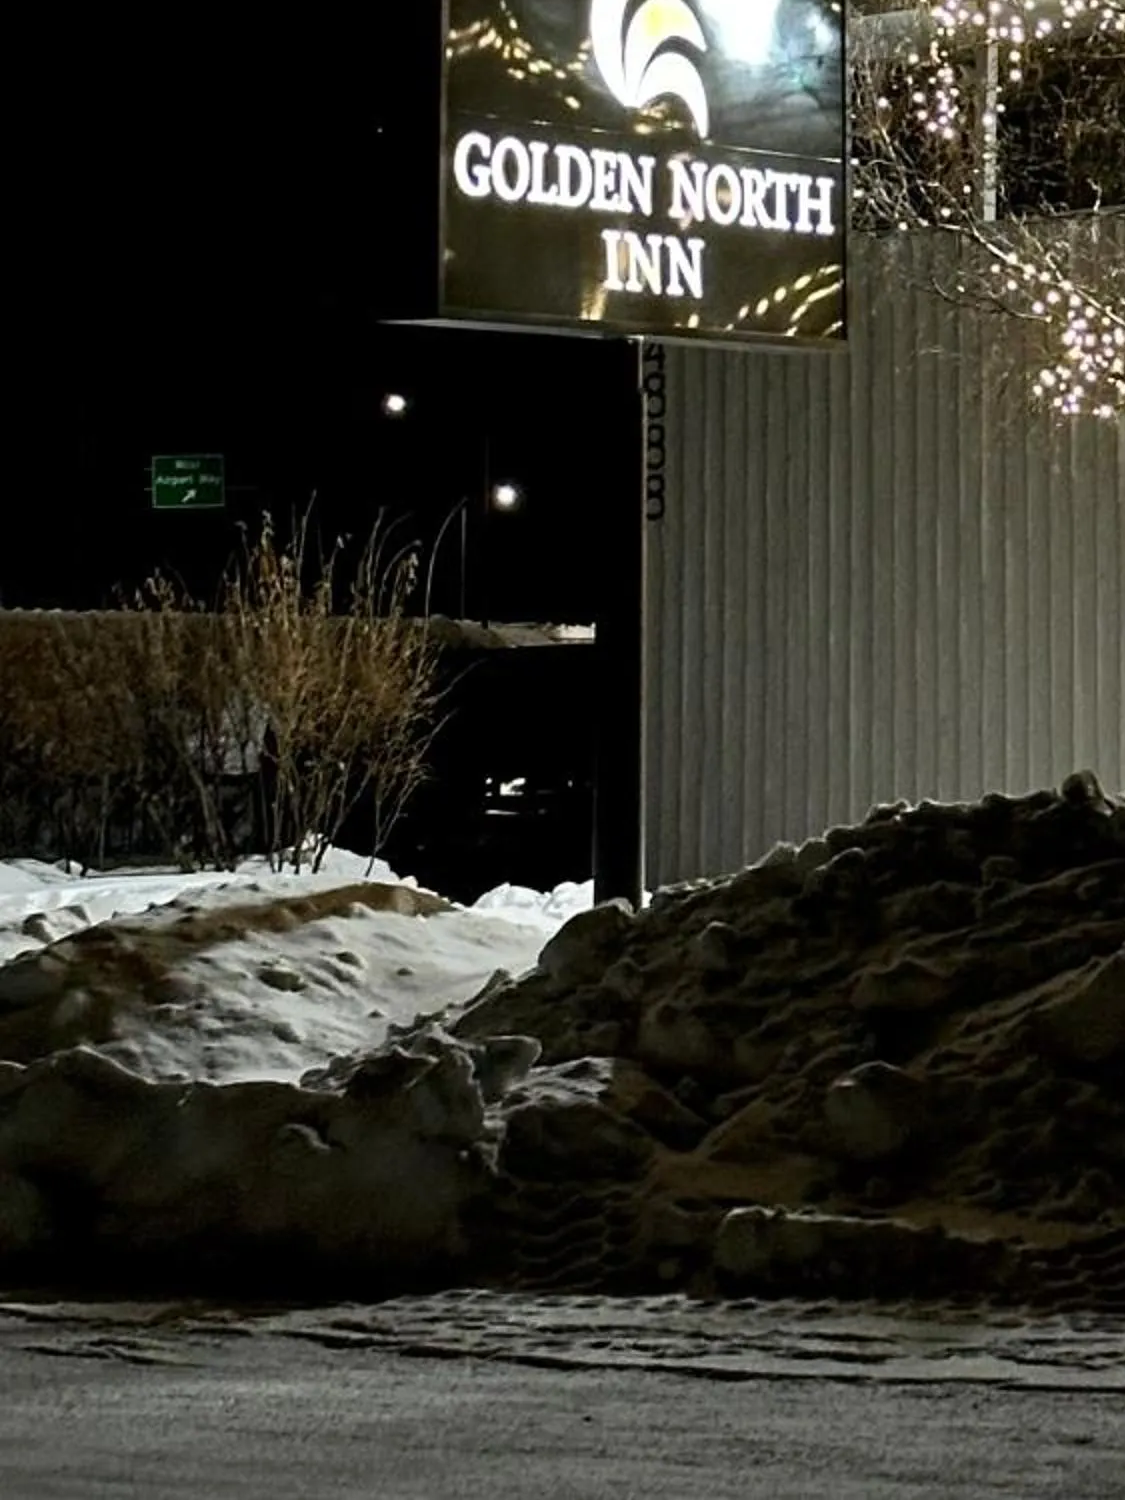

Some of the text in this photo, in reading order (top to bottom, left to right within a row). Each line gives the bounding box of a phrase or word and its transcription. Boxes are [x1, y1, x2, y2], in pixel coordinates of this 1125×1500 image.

[453, 131, 836, 235] GOLDEN NORTH
[601, 229, 705, 299] INN
